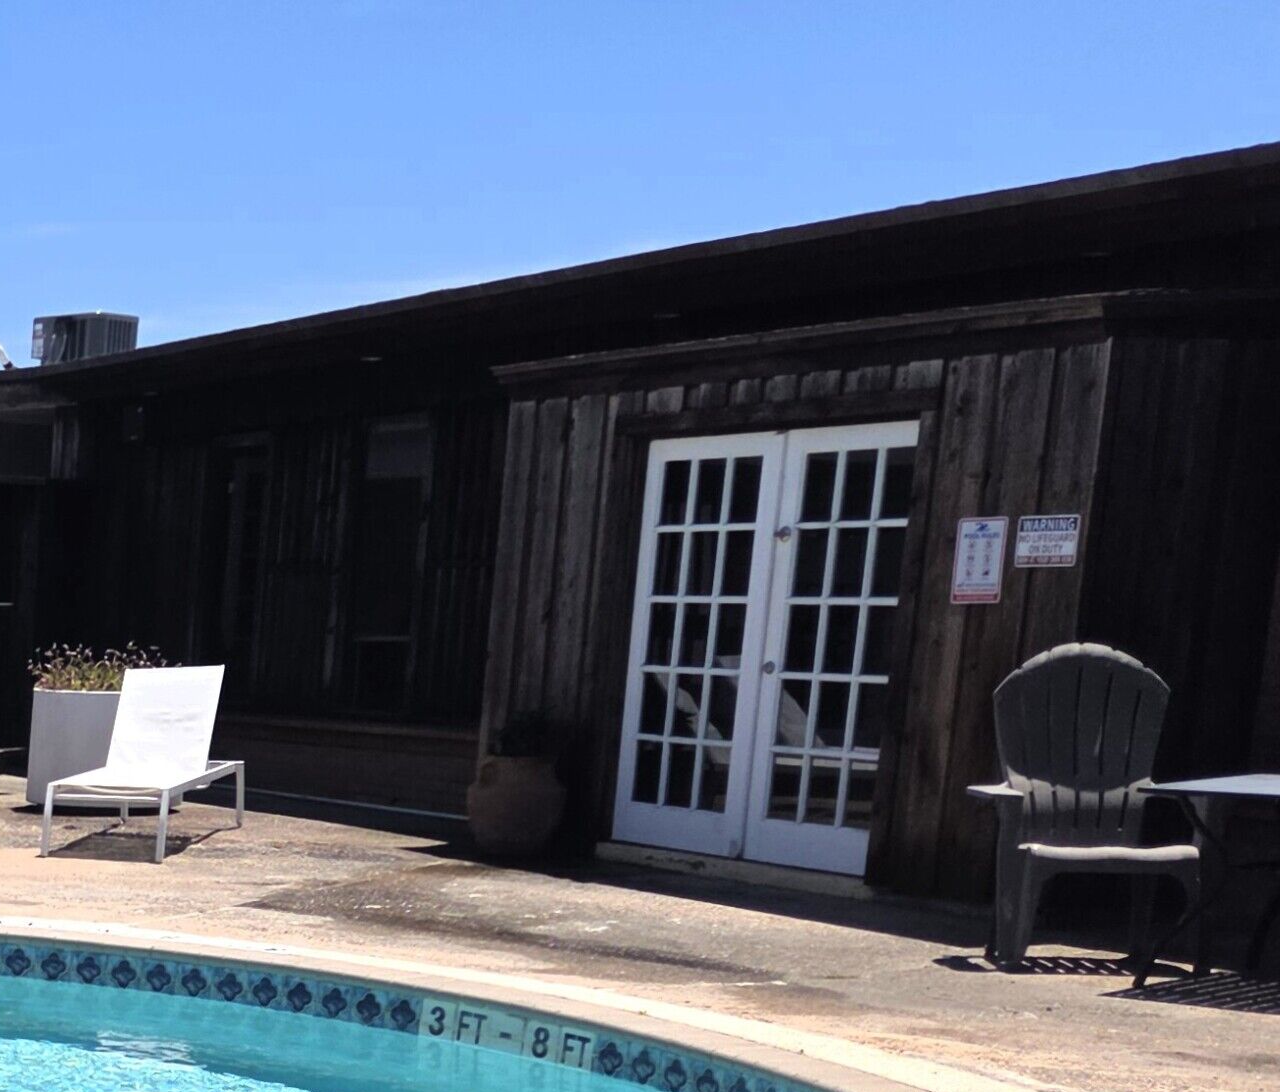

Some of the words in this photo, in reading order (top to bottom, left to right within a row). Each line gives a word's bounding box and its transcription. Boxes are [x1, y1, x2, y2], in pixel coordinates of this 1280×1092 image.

[1022, 517, 1076, 532] WARNING
[1019, 533, 1031, 544] NO
[1032, 532, 1076, 543] LIFEGUARD
[1028, 545, 1041, 555] ON
[1042, 543, 1064, 554] DUTY
[428, 1006, 445, 1036] 3
[456, 1010, 488, 1045] FT
[531, 1026, 550, 1058] 8
[560, 1032, 591, 1068] FT
